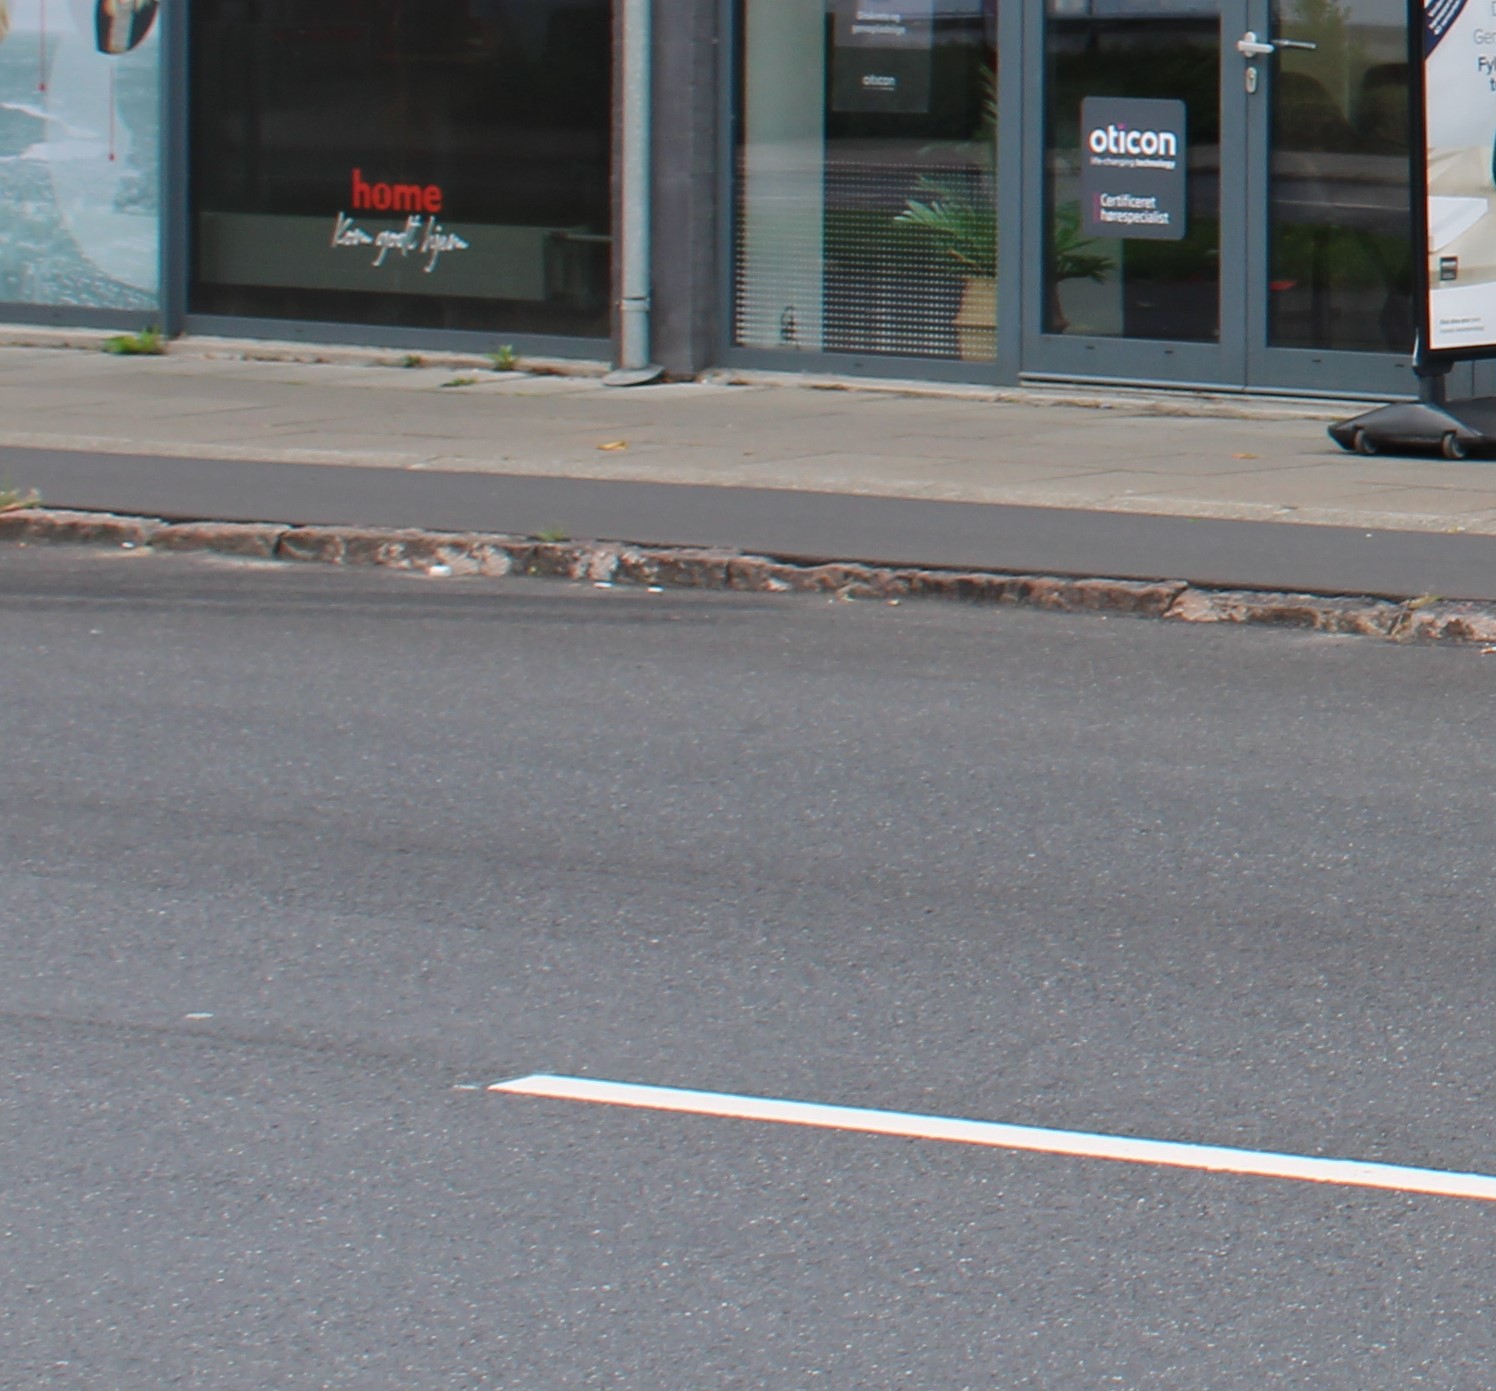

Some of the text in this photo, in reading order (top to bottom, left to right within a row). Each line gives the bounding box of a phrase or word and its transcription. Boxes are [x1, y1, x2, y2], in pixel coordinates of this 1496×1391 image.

[1089, 124, 1176, 156] oticon
[352, 168, 442, 212] home
[1100, 193, 1156, 208] Certificeret
[1100, 209, 1169, 225] hørespecialist
